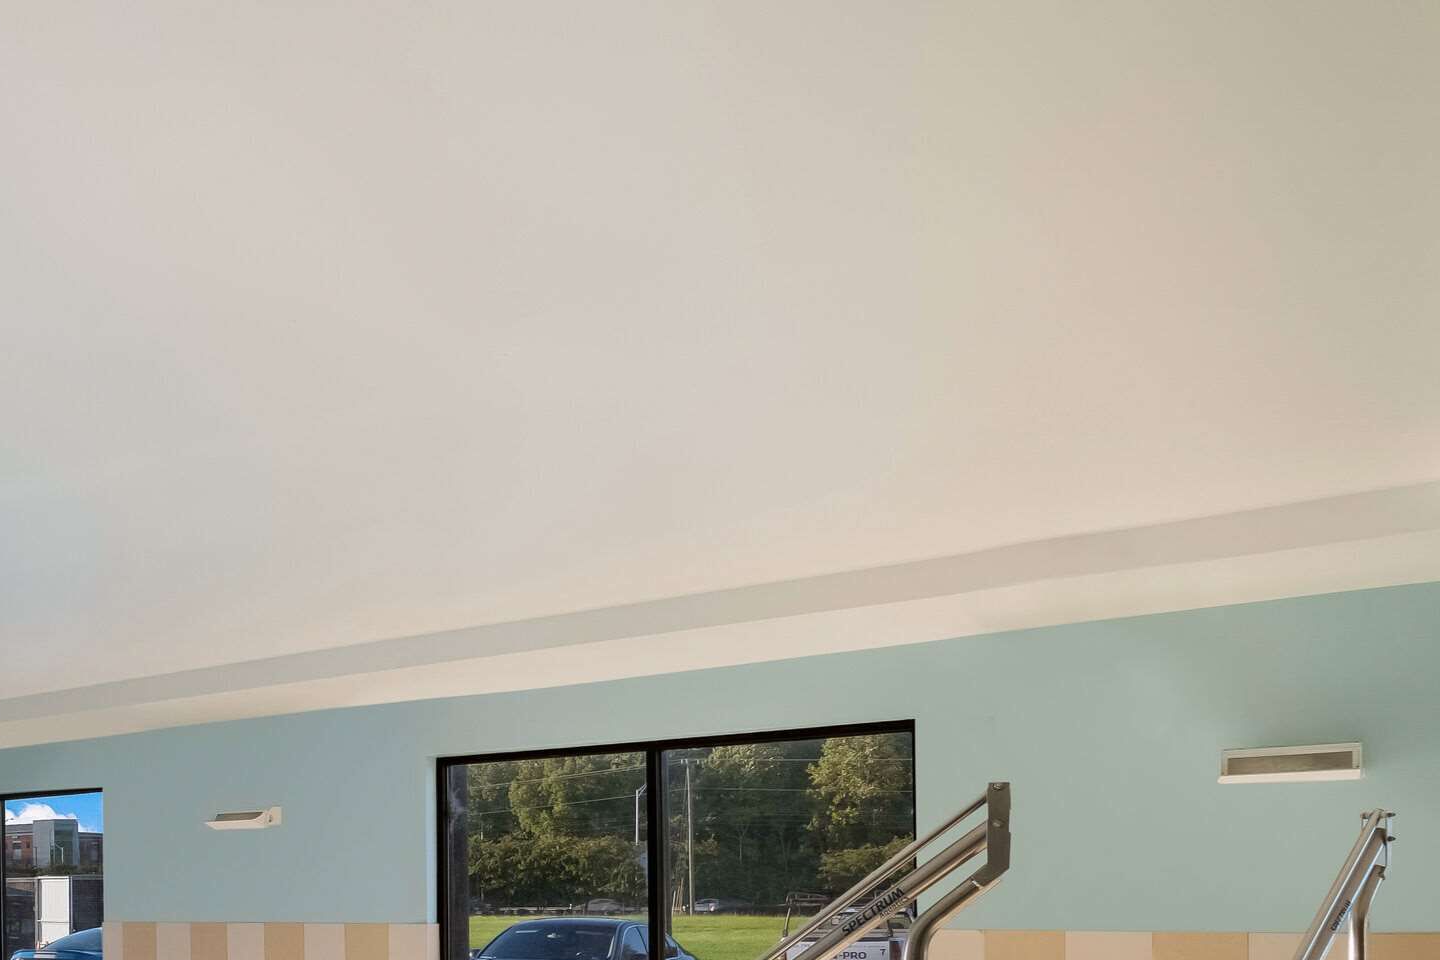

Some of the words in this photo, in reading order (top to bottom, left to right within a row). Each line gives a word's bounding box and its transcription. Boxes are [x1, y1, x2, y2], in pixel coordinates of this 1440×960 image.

[842, 887, 904, 936] SPECTRUM
[833, 951, 867, 959] -PRO
[879, 948, 886, 957] 7
